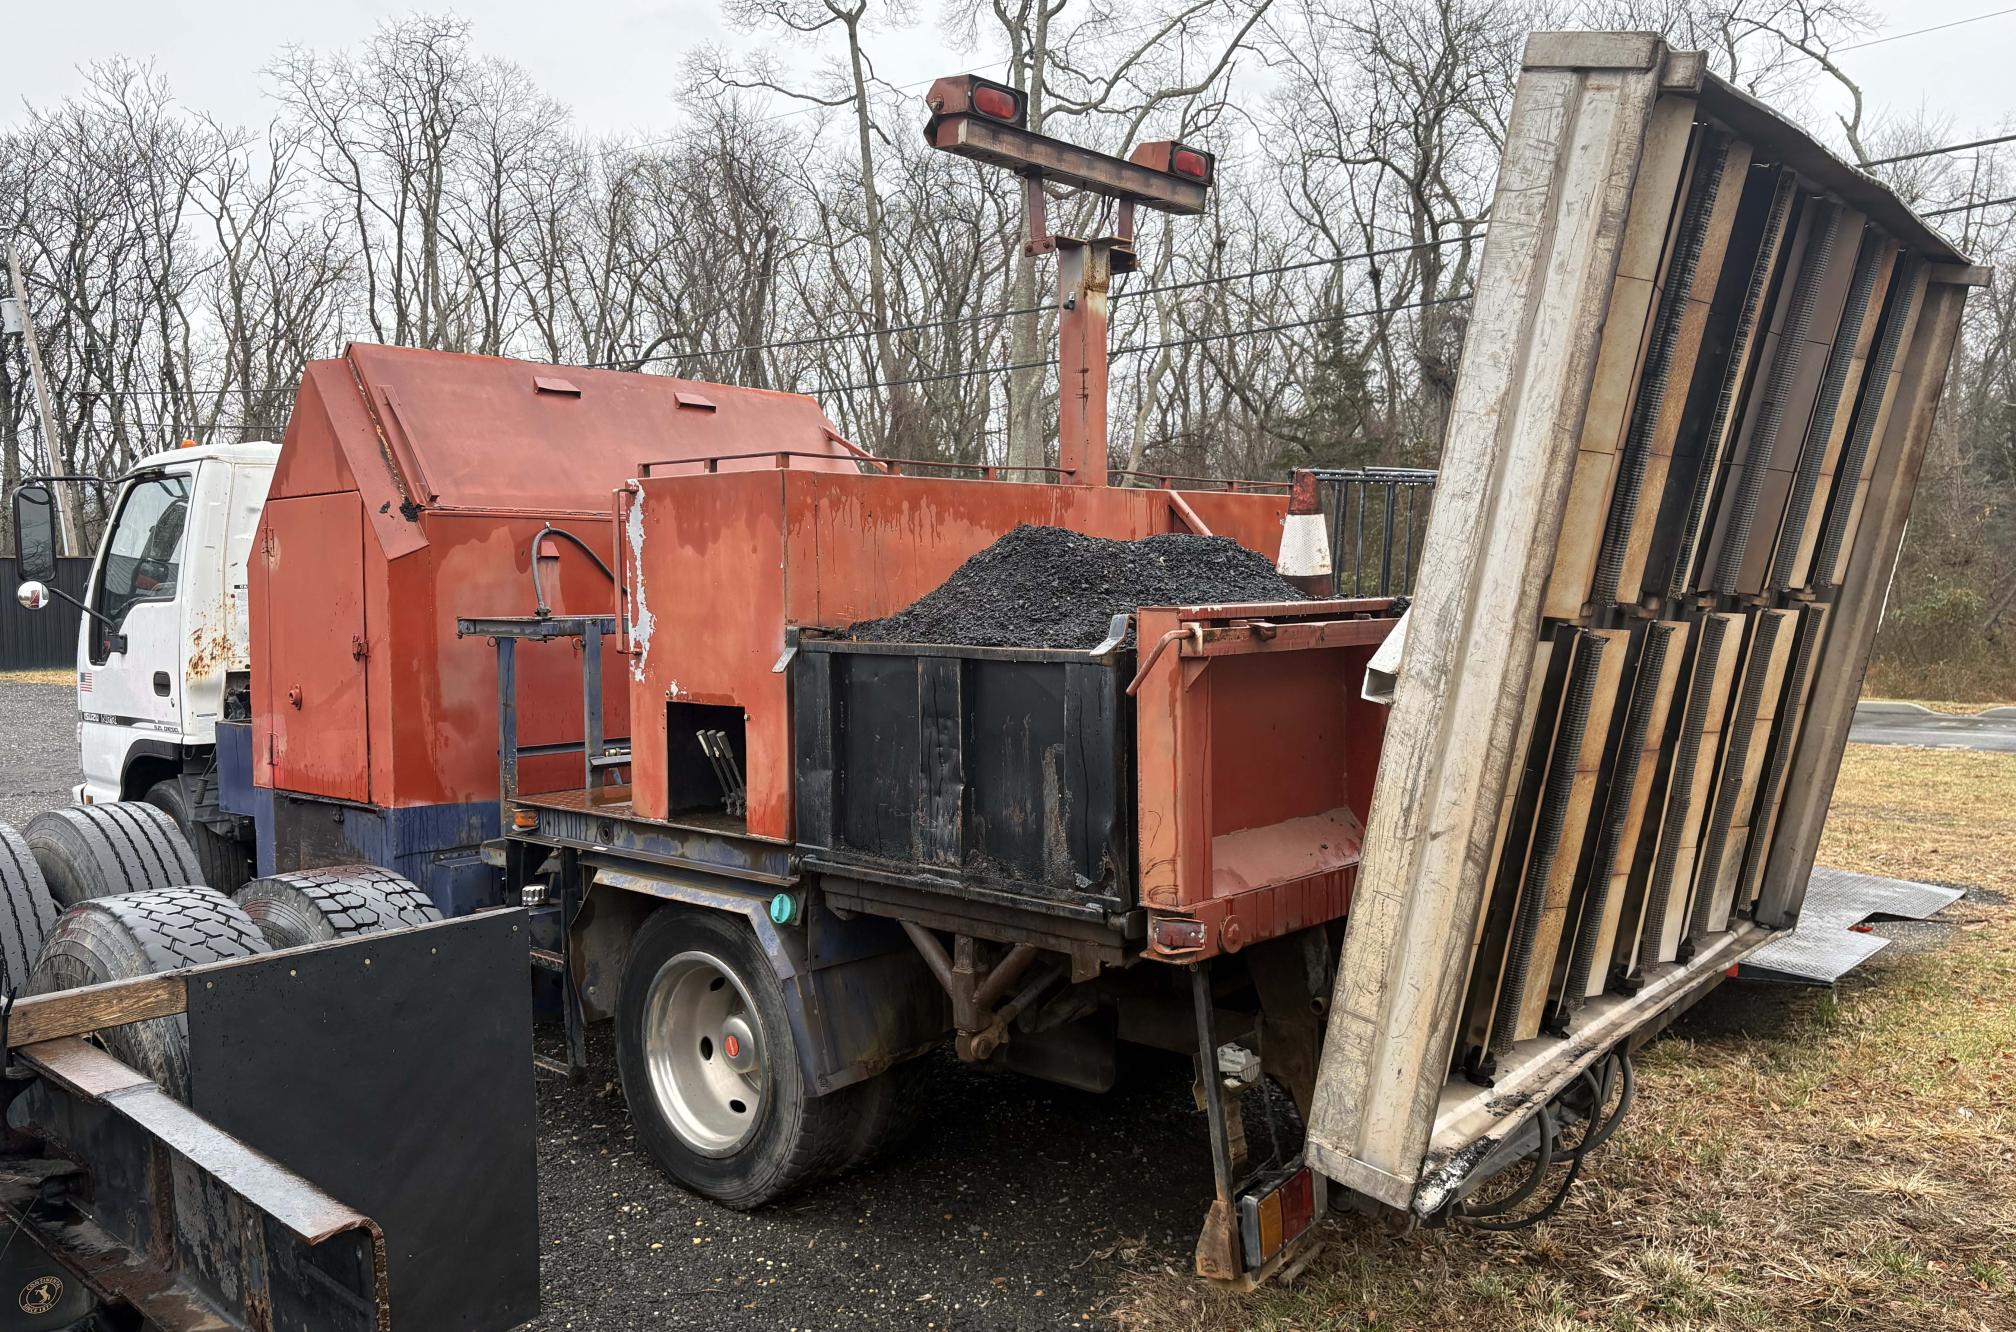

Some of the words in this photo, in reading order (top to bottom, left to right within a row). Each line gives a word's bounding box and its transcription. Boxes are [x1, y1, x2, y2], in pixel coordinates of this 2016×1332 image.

[83, 712, 99, 721] ISUZU
[26, 1277, 61, 1291] CONTINENTAL
[23, 1303, 38, 1313] SINCE
